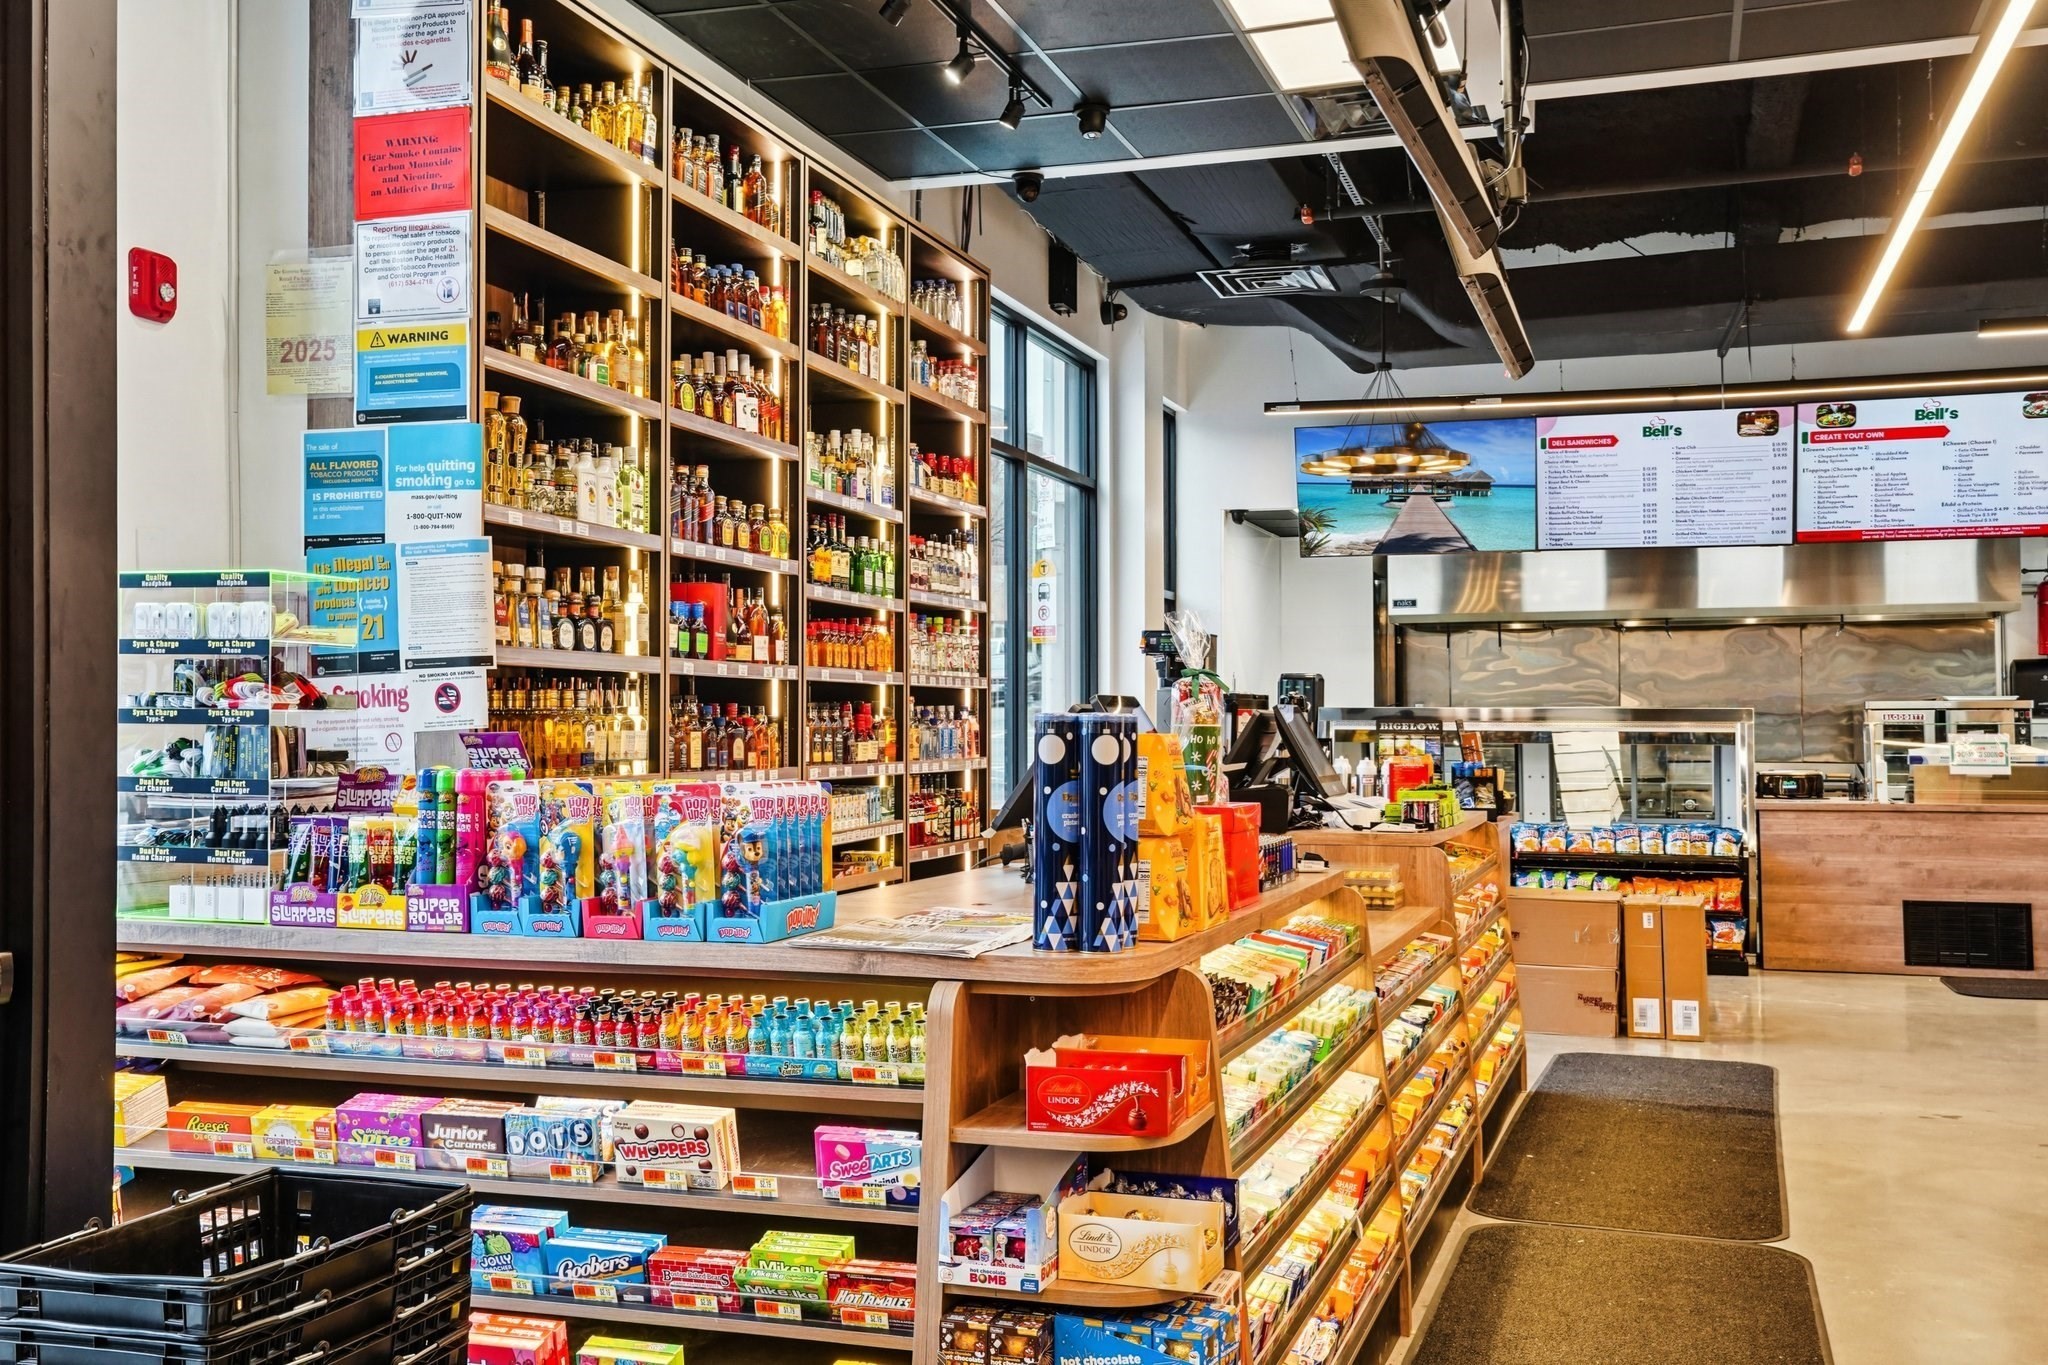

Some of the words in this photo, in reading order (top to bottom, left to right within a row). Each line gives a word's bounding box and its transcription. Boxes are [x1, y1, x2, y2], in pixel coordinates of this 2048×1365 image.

[411, 12, 436, 22] non-FDA
[438, 10, 466, 20] approved
[422, 20, 448, 28] Products
[426, 30, 438, 38] age
[415, 37, 452, 46] e-cigarettes.
[386, 136, 438, 147] WARNING:
[362, 153, 386, 162] Cigar
[388, 150, 420, 159] Smoke
[422, 146, 462, 156] Contains
[372, 162, 405, 173] Carbon
[408, 158, 454, 169] Monoxide
[382, 174, 399, 184] and
[370, 189, 382, 197] an
[384, 184, 428, 195] Addictive
[431, 182, 455, 191] Drug.
[373, 225, 407, 234] Reporting
[427, 238, 454, 246] products
[414, 254, 433, 262] Public
[427, 261, 460, 269] Prevention
[388, 330, 448, 344] WARNING
[280, 339, 336, 363] 2025
[1915, 408, 1959, 420] Bell's
[1642, 425, 1682, 437] Bell's
[1843, 432, 1864, 440] YOUT
[332, 442, 338, 450] of
[1567, 438, 1612, 446] SANDWICHES
[310, 462, 326, 470] ALL
[330, 460, 378, 470] FLAVORED
[396, 464, 407, 472] For
[409, 464, 425, 473] help
[426, 460, 475, 474] quitting
[395, 474, 452, 489] smoking
[454, 480, 464, 488] go
[466, 478, 475, 486] to
[312, 493, 321, 501] IS
[323, 490, 383, 500] PROHIBITED
[406, 512, 462, 520] 1-800-QUIT-NOW
[314, 564, 321, 574] It
[322, 563, 331, 574] is
[334, 556, 374, 573] illegal
[145, 574, 168, 582] Quality
[220, 573, 244, 581] Quality
[334, 576, 390, 593] tobacco
[314, 598, 356, 612] products
[361, 614, 385, 640] 21
[132, 640, 148, 648] Sync
[156, 640, 179, 648] Charge
[208, 640, 224, 648] Sync
[232, 640, 255, 648] Charge
[132, 709, 148, 717] Sync
[155, 709, 178, 717] Charge
[208, 709, 223, 717] Sync
[230, 709, 254, 717] Charge
[468, 748, 520, 759] SUPER
[471, 758, 528, 768] ROLLER
[140, 778, 154, 786] Dual
[156, 778, 170, 786] Port
[215, 780, 230, 788] Dual
[232, 780, 246, 788] Port
[337, 789, 398, 807] SLURPERS
[150, 854, 177, 862] Charger
[408, 898, 460, 912] SUPER
[272, 906, 336, 923] SLURPERS
[339, 910, 404, 926] SLURPERS
[408, 912, 463, 925] ROLLER
[778, 1068, 802, 1076] ENERGY
[1048, 1096, 1080, 1106] LINDOR
[186, 1115, 230, 1133] Reese's
[428, 1123, 488, 1140] Junior
[262, 1134, 302, 1146] Raisinets
[350, 1129, 410, 1146] Spree
[510, 1122, 593, 1155] DOTS
[445, 1140, 497, 1151] Caramels
[620, 1139, 709, 1160] WHOPPERS
[830, 1150, 912, 1179] SweeTARTS
[1335, 1180, 1358, 1191] SHARE
[1337, 1190, 1354, 1198] SIZE
[1078, 1229, 1106, 1243] Lindt
[1079, 1245, 1111, 1255] LINDOR
[480, 1254, 512, 1268] JOLLY
[558, 1256, 630, 1280] Goobers
[662, 1269, 692, 1282] Boston
[692, 1272, 707, 1280] Baked
[746, 1285, 788, 1298] Mike
[793, 1289, 818, 1300] Ike
[836, 1290, 859, 1308] HOT
[860, 1293, 912, 1309] TAMALES
[1060, 1356, 1075, 1365] hot
[1078, 1354, 1140, 1365] chocolate
